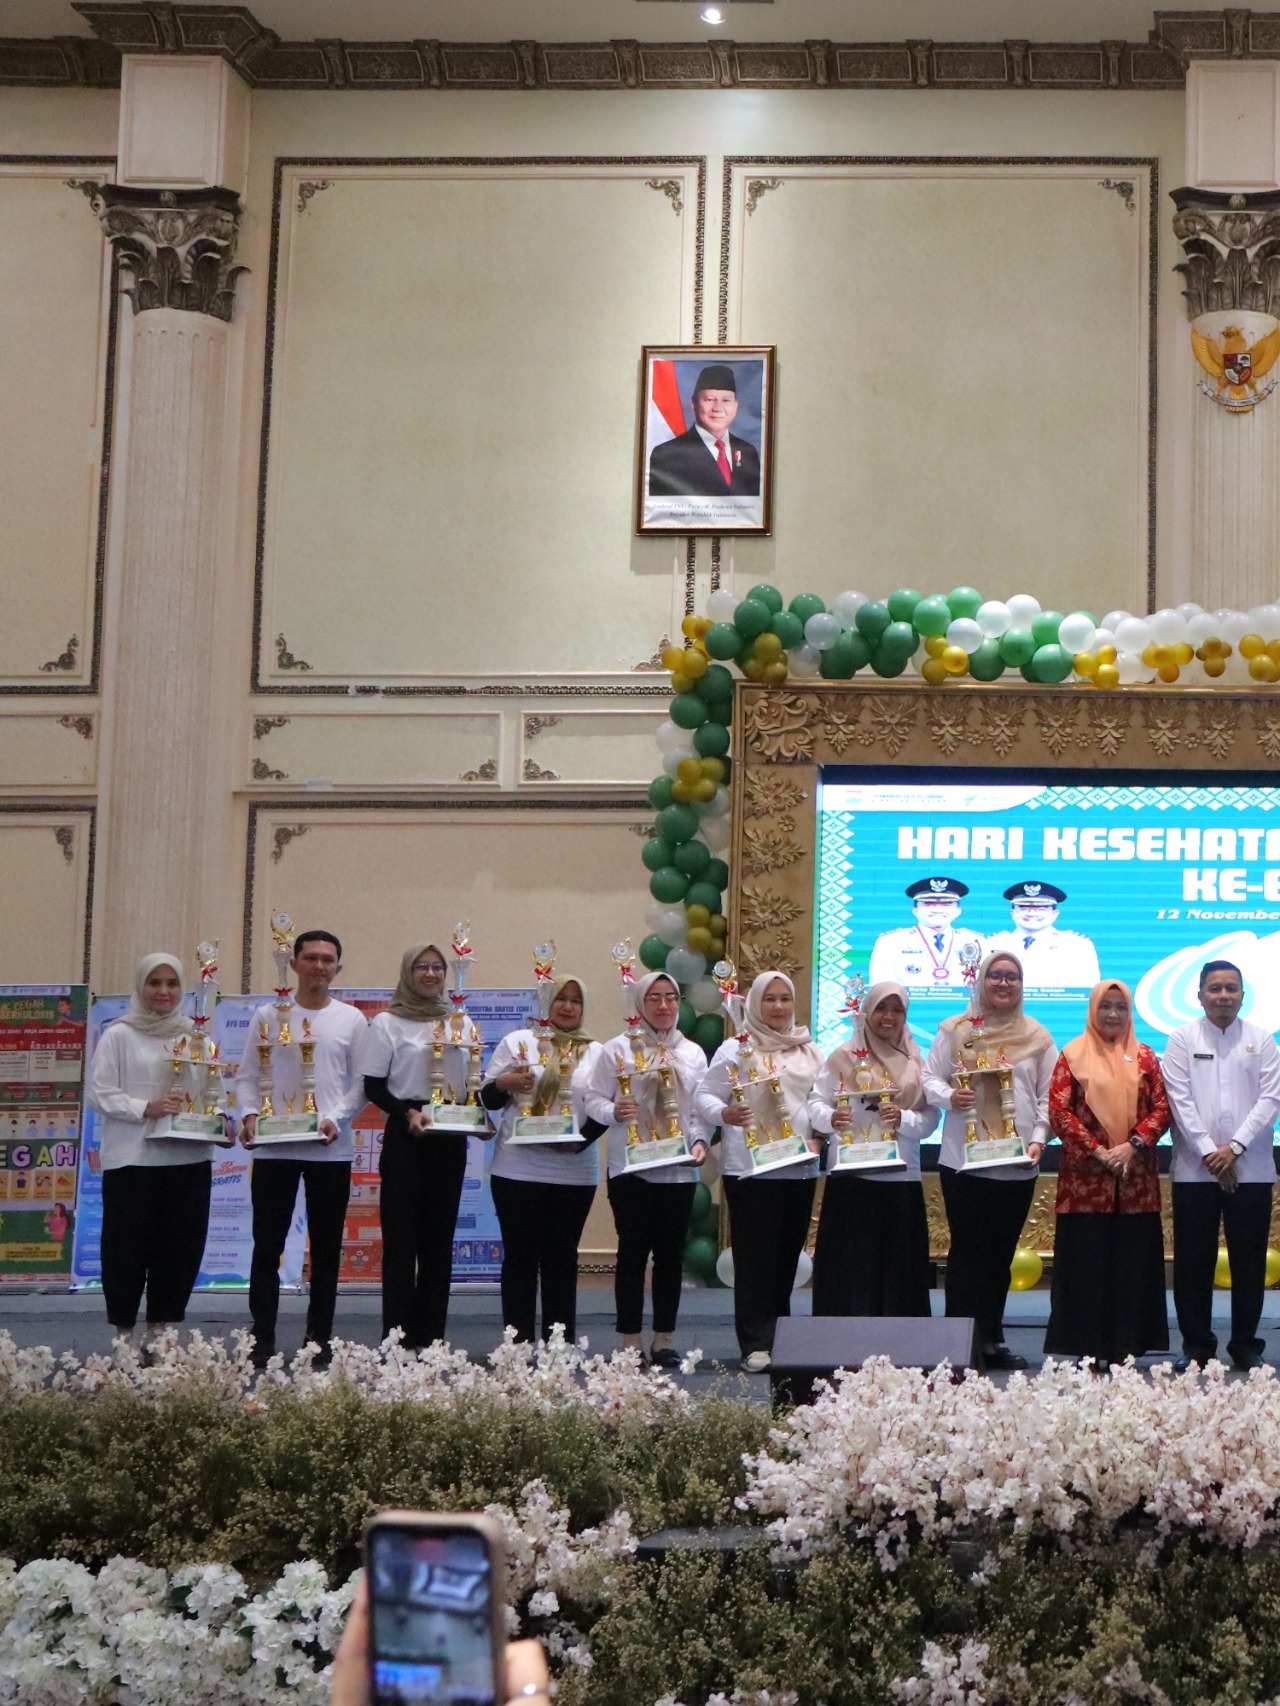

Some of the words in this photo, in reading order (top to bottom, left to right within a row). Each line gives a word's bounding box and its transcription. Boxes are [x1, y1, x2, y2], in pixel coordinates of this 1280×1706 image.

[898, 826, 1024, 860] HARI
[1156, 909, 1180, 920] 12
[0, 1010, 55, 1020] BERKULOSIS
[0, 1144, 77, 1168] EGAH
